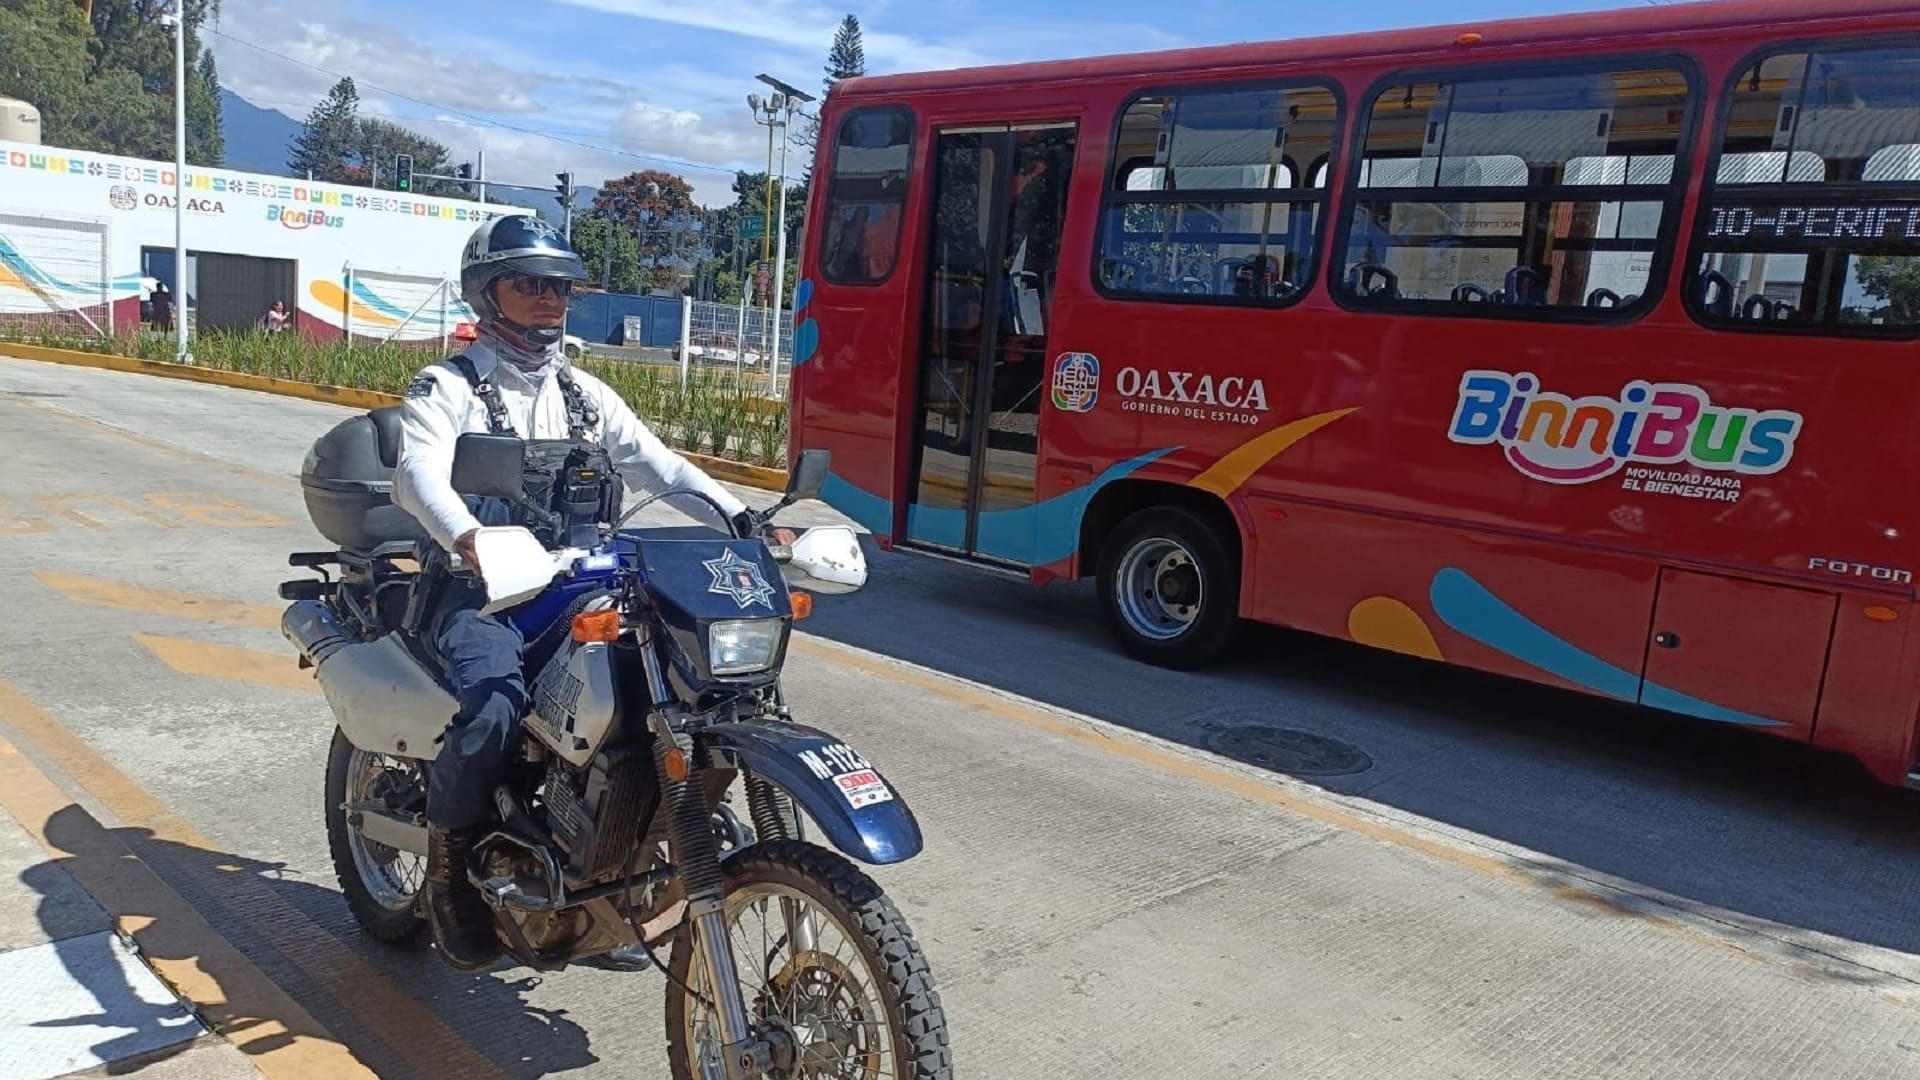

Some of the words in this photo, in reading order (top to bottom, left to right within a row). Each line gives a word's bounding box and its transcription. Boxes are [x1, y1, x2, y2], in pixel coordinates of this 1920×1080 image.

[266, 204, 344, 229] BinniBus
[1116, 367, 1269, 410] OAXACA
[1121, 402, 1179, 415] GOBIERNO
[1185, 407, 1206, 419] DEL
[1211, 410, 1258, 424] ESTADO
[1451, 371, 1801, 478] BinniBus
[1621, 478, 1642, 492] EL
[1644, 480, 1740, 503] BIENESTAR
[1625, 467, 1702, 486] MOVILIDAD
[1703, 474, 1742, 490] PARA
[1808, 557, 1912, 585] FOTON
